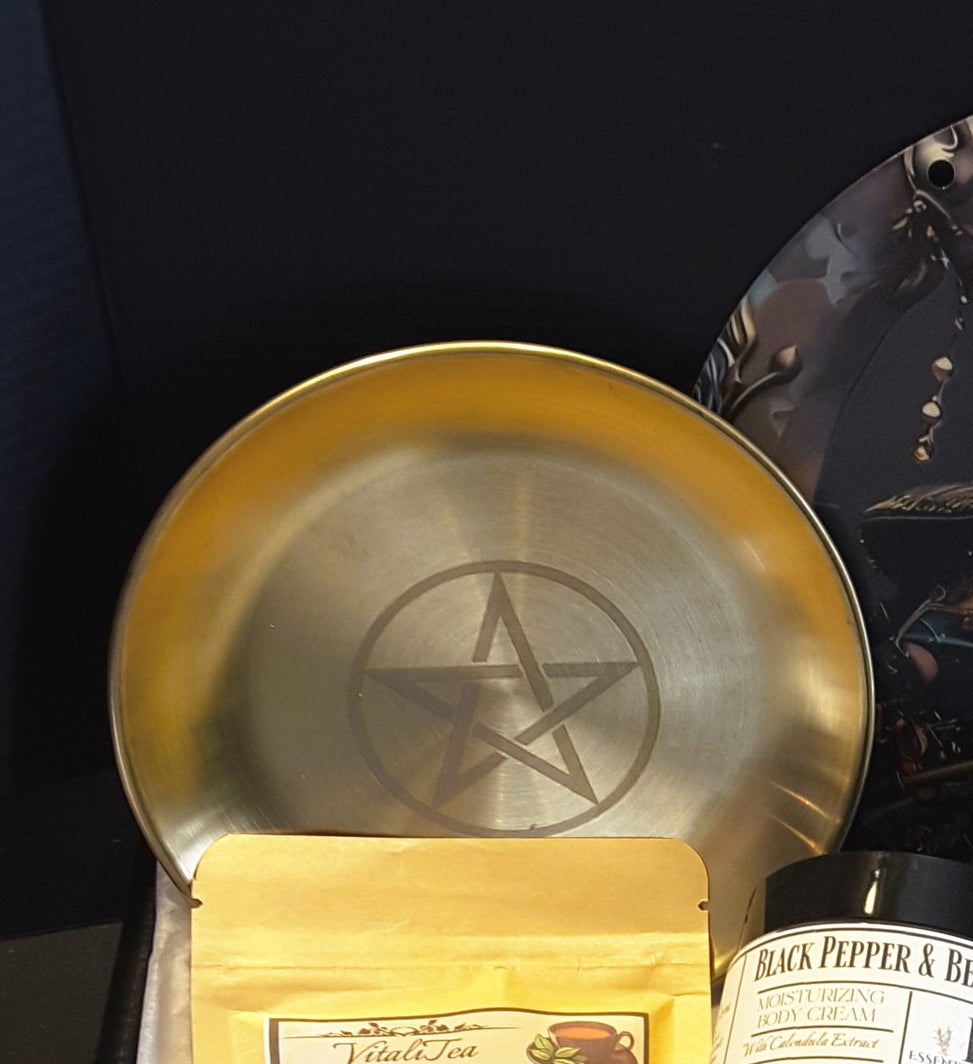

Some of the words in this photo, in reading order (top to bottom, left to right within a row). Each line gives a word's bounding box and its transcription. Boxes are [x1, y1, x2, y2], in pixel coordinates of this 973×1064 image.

[754, 942, 815, 983] BLACK
[819, 935, 911, 972] PEPPER
[918, 943, 936, 978] &
[759, 988, 884, 1010] MOISTURIZING
[757, 1008, 797, 1029] BODY
[807, 1006, 876, 1023] CREAM
[770, 1032, 829, 1051] Calendula
[831, 1033, 880, 1049] Extract
